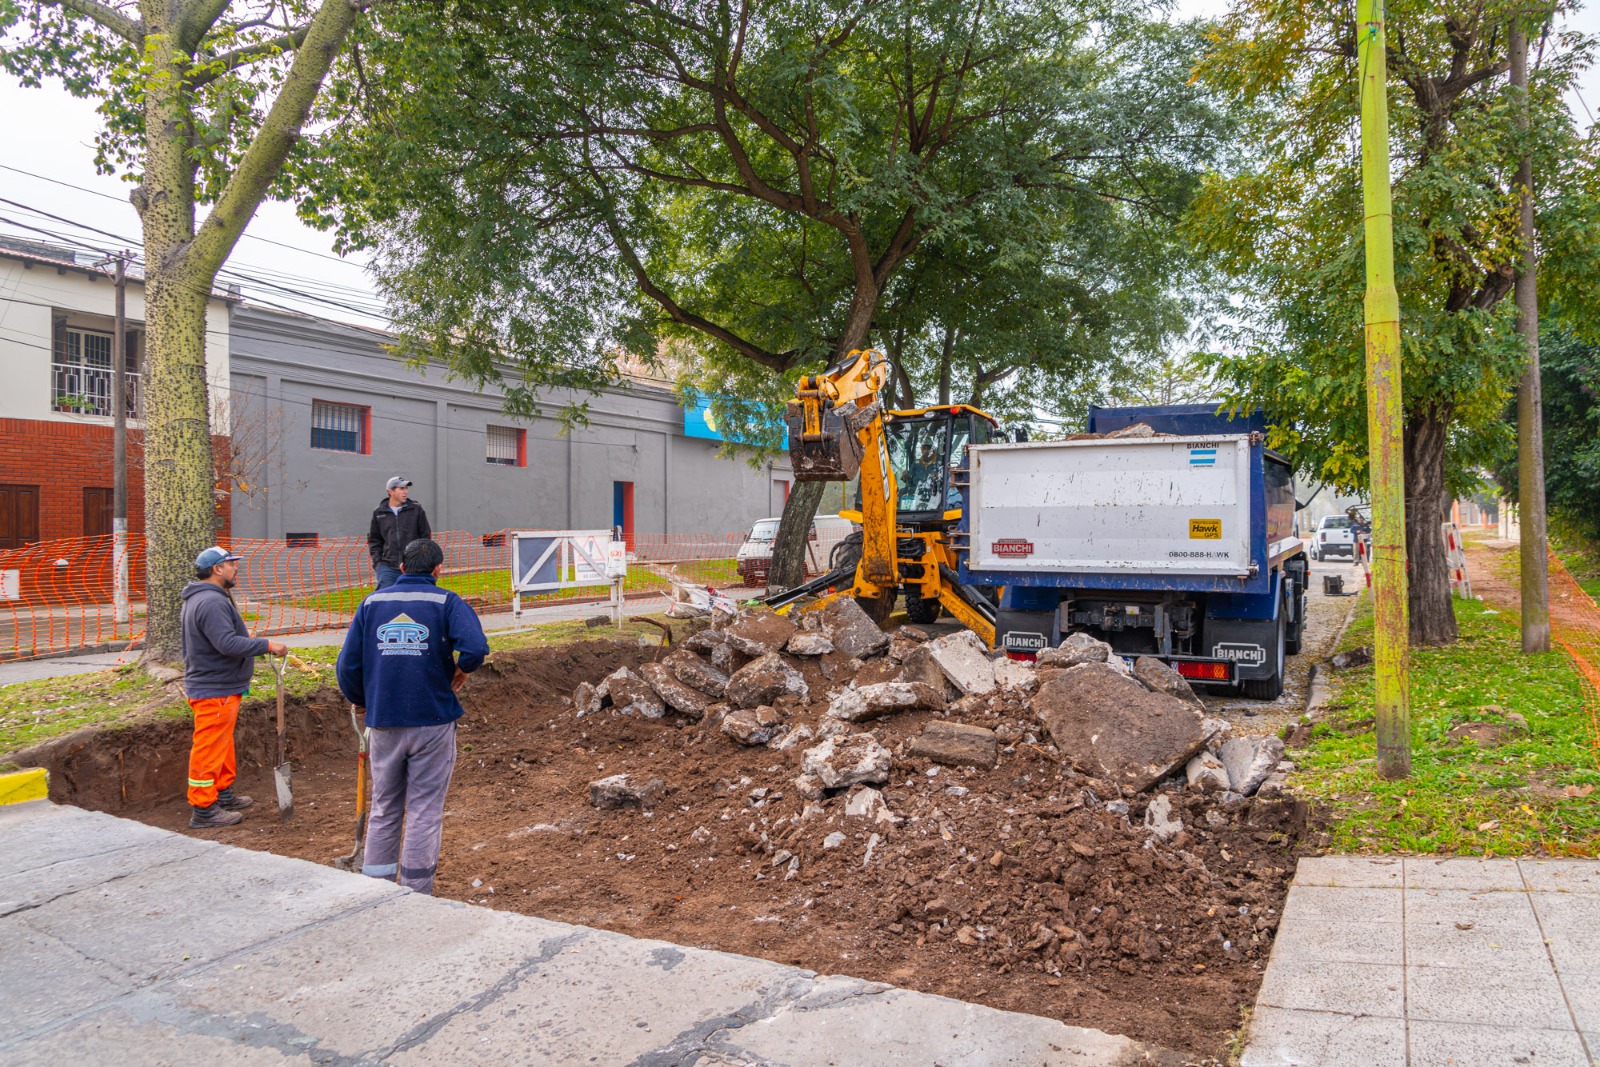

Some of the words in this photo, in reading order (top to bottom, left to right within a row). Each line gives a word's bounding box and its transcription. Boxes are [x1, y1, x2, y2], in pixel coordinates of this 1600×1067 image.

[993, 544, 1032, 553] BIANCHI
[1006, 637, 1044, 648] BIANCHI
[1217, 649, 1261, 660] BIANCHI
